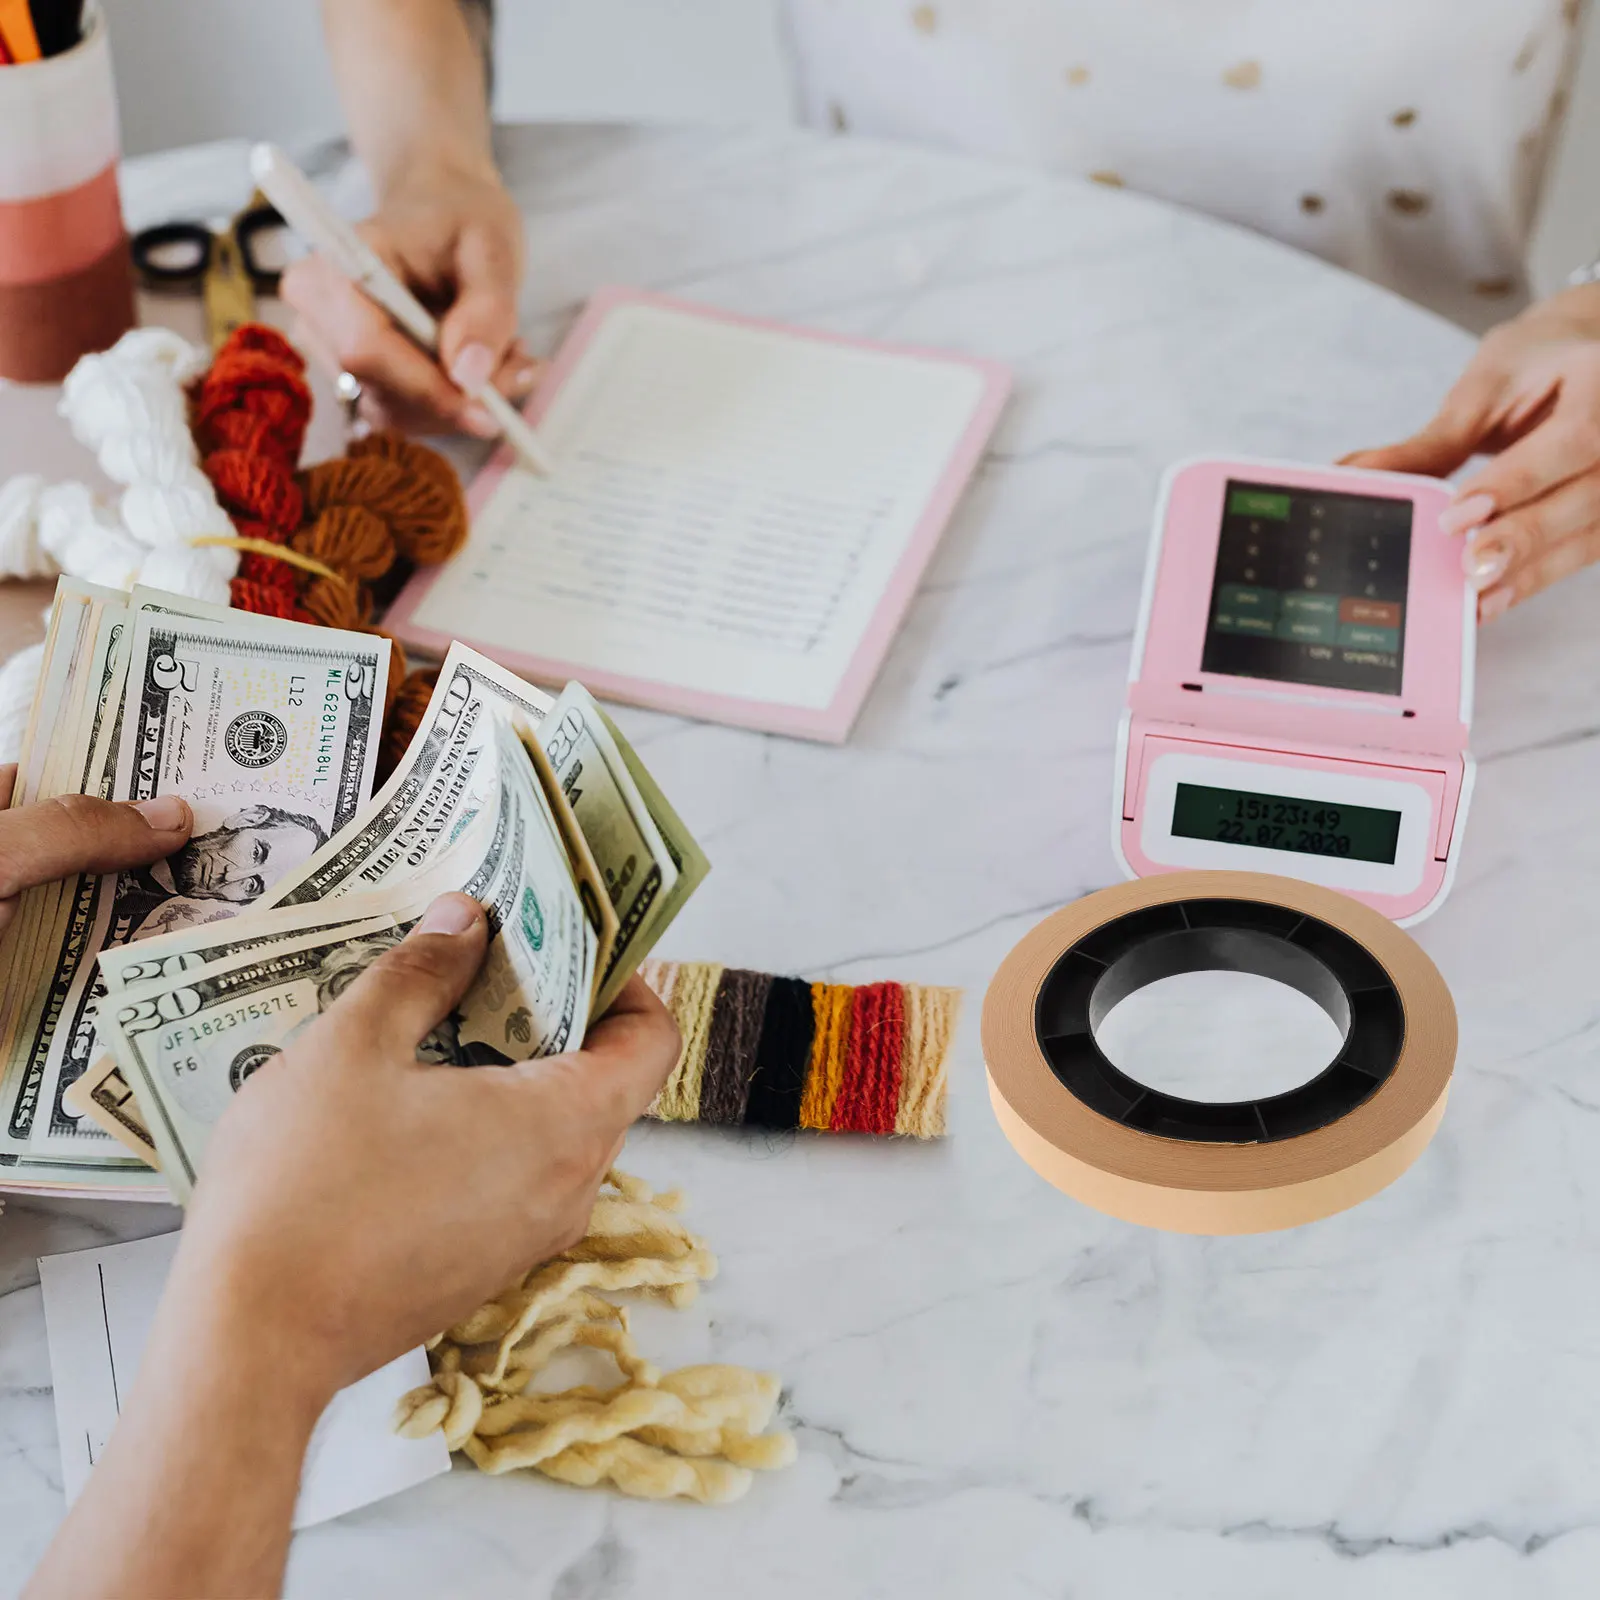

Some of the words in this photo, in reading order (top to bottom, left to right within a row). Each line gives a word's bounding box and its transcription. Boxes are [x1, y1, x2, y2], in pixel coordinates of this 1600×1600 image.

[152, 654, 200, 692] 5
[288, 676, 306, 707] L12
[326, 669, 342, 688] ML
[345, 662, 373, 701] 5
[433, 675, 472, 739] 10
[315, 693, 339, 773] 62814484
[313, 778, 328, 786] L
[342, 739, 361, 813] FEDERAL
[359, 848, 400, 883] THE
[393, 779, 447, 849] UNITED
[441, 699, 481, 775] STATES
[407, 838, 432, 867] OF
[425, 748, 480, 843] AMERICA
[1234, 797, 1341, 831] 15:23:49
[311, 829, 380, 890] RESERVE
[384, 777, 420, 824] NOTE
[1217, 819, 1350, 855] 22.07.2020
[218, 956, 306, 989] FEDERAL
[118, 987, 203, 1038] 20
[164, 1031, 185, 1050] JF
[189, 997, 282, 1041] 18237527
[286, 993, 299, 1008] E
[15, 988, 66, 1129] DOLLARS
[173, 1056, 198, 1076] F6
